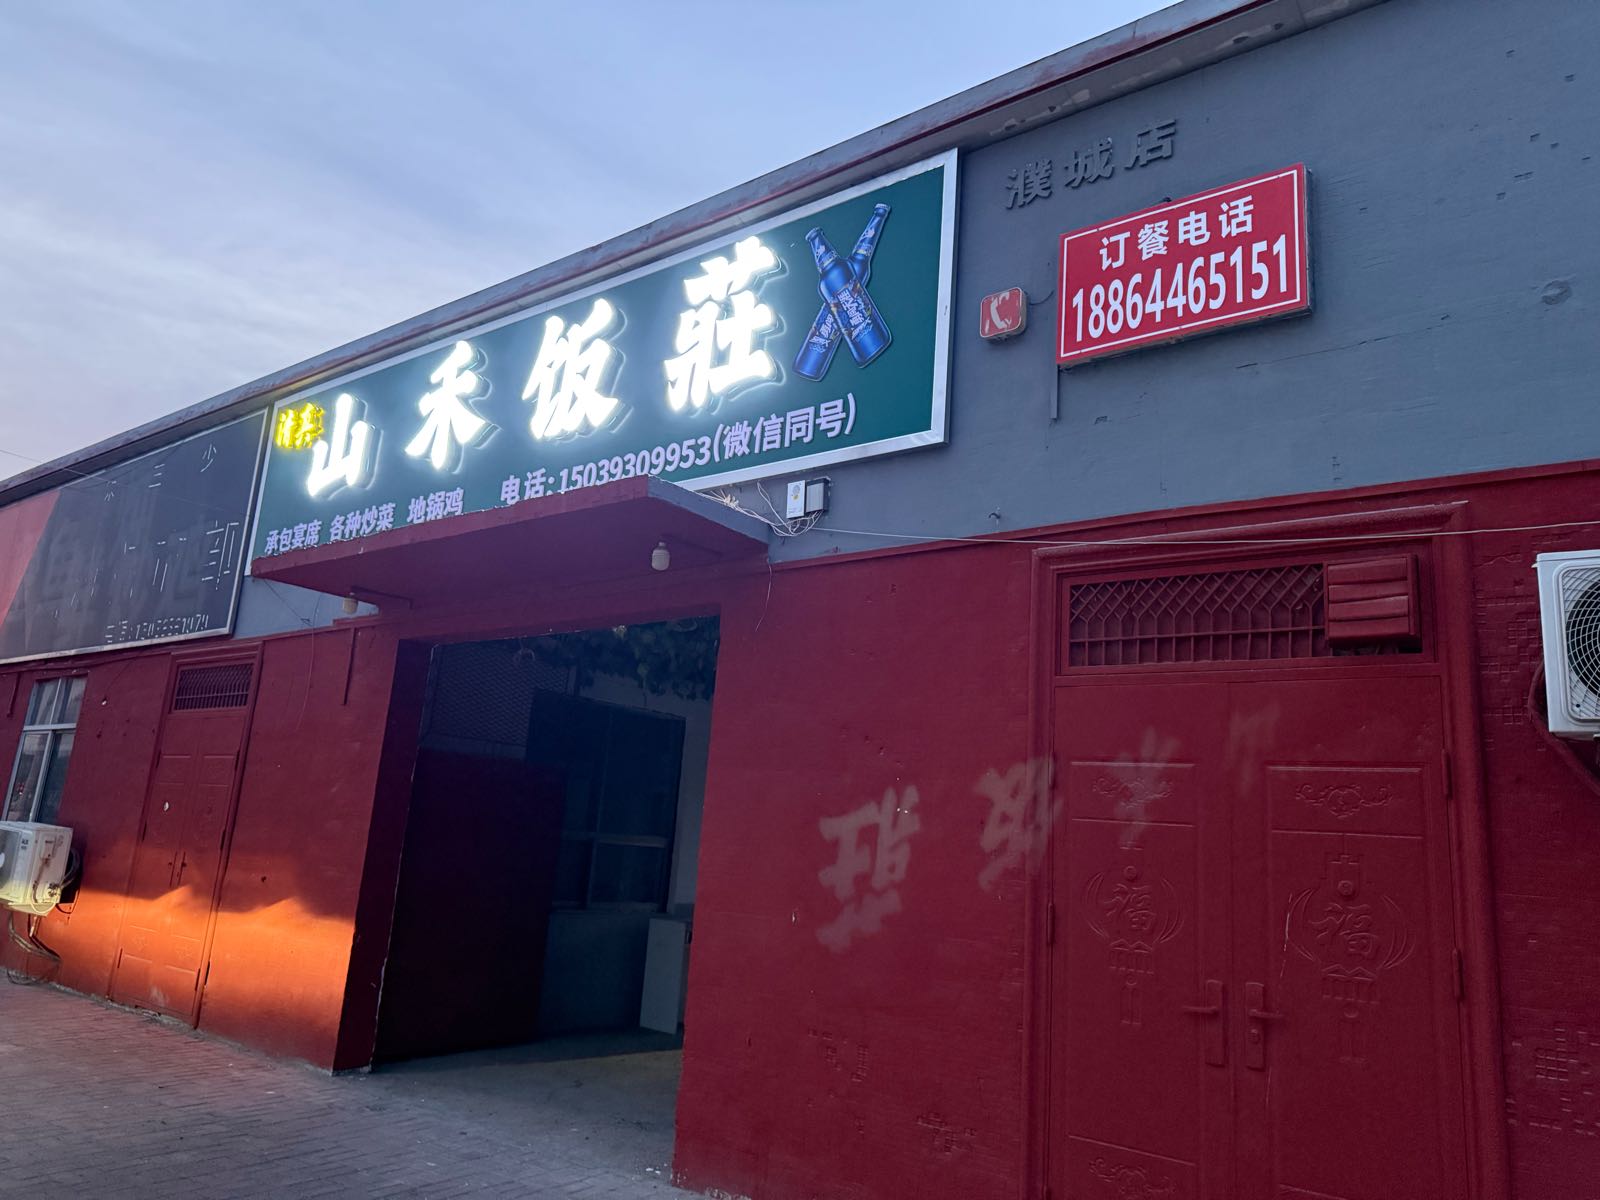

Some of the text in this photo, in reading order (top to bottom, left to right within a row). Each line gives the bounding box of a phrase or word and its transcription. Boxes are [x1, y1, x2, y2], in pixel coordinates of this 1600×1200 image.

[1004, 119, 1178, 210] 濮城店
[1099, 195, 1254, 271] 订餐电话
[1072, 234, 1288, 342] 18864465151
[264, 519, 323, 555] 承包宴席
[328, 502, 396, 541] 各种炒菜
[406, 487, 465, 524] 地锅鸡
